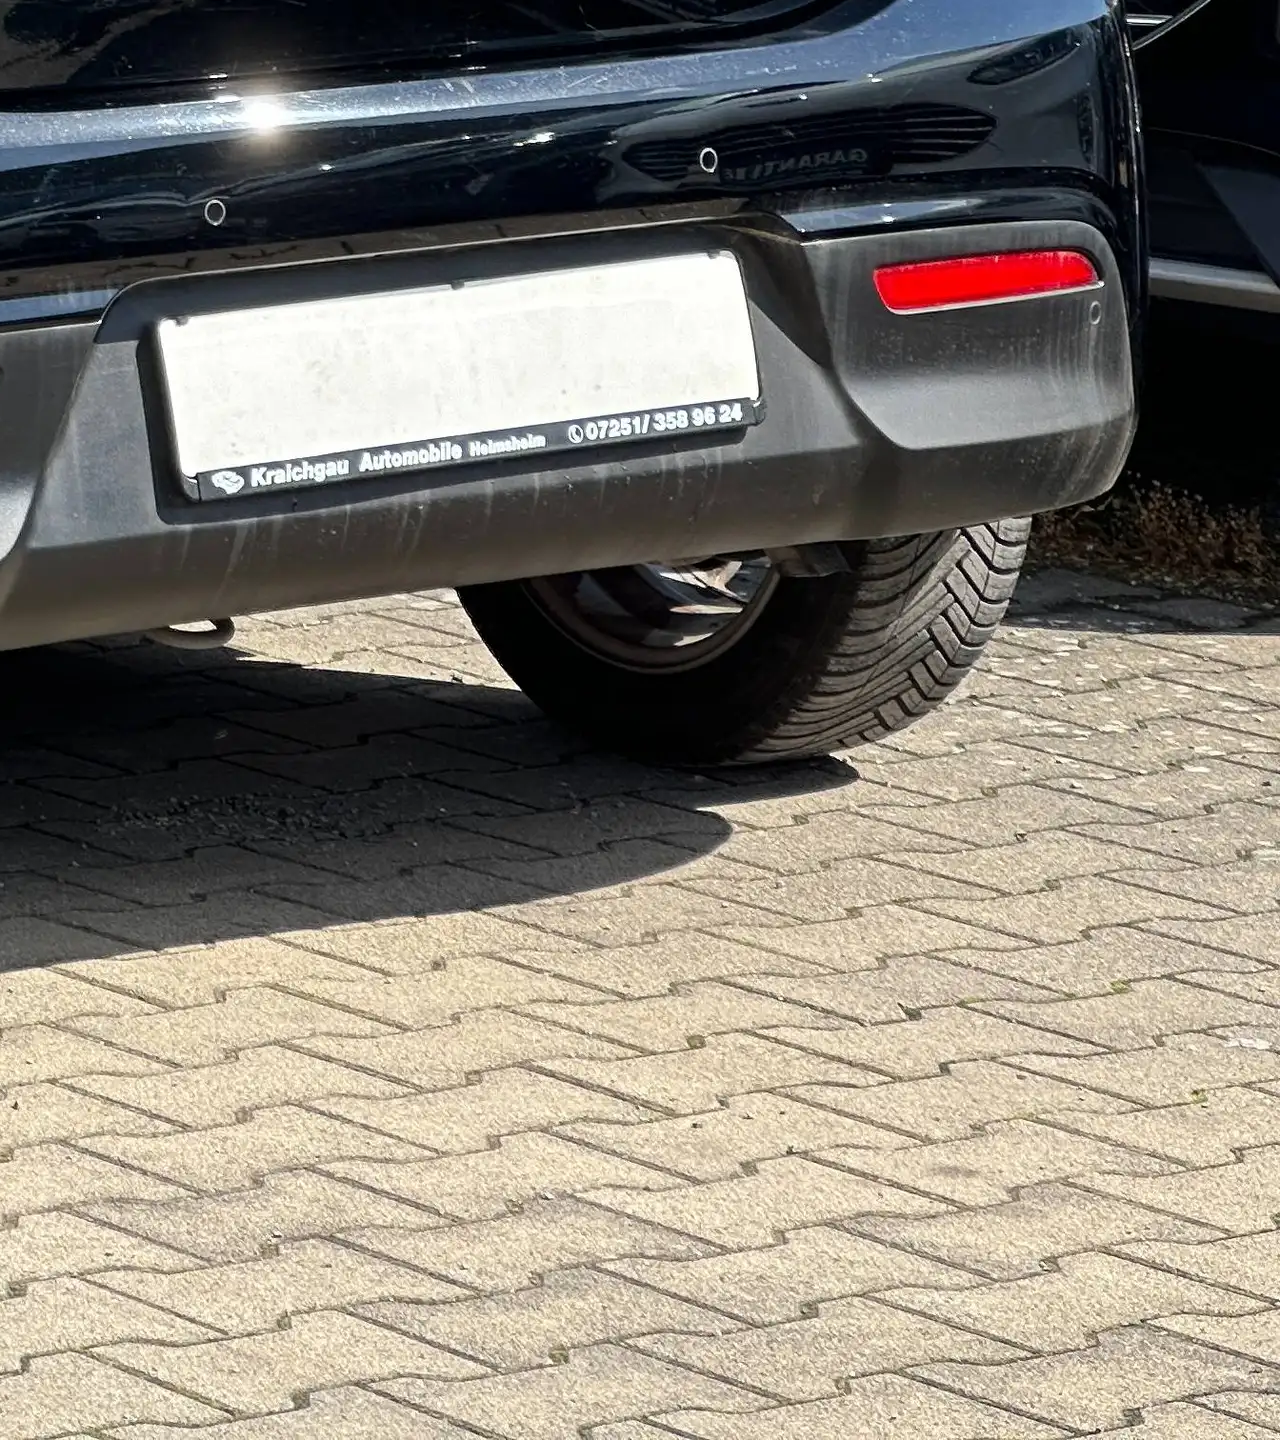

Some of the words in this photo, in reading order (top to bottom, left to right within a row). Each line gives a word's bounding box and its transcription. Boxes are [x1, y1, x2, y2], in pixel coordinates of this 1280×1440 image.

[251, 459, 350, 487] Kraichgau
[359, 442, 462, 472] Automobile
[654, 410, 689, 431] 358
[692, 406, 716, 426] 96
[720, 402, 743, 422] 24
